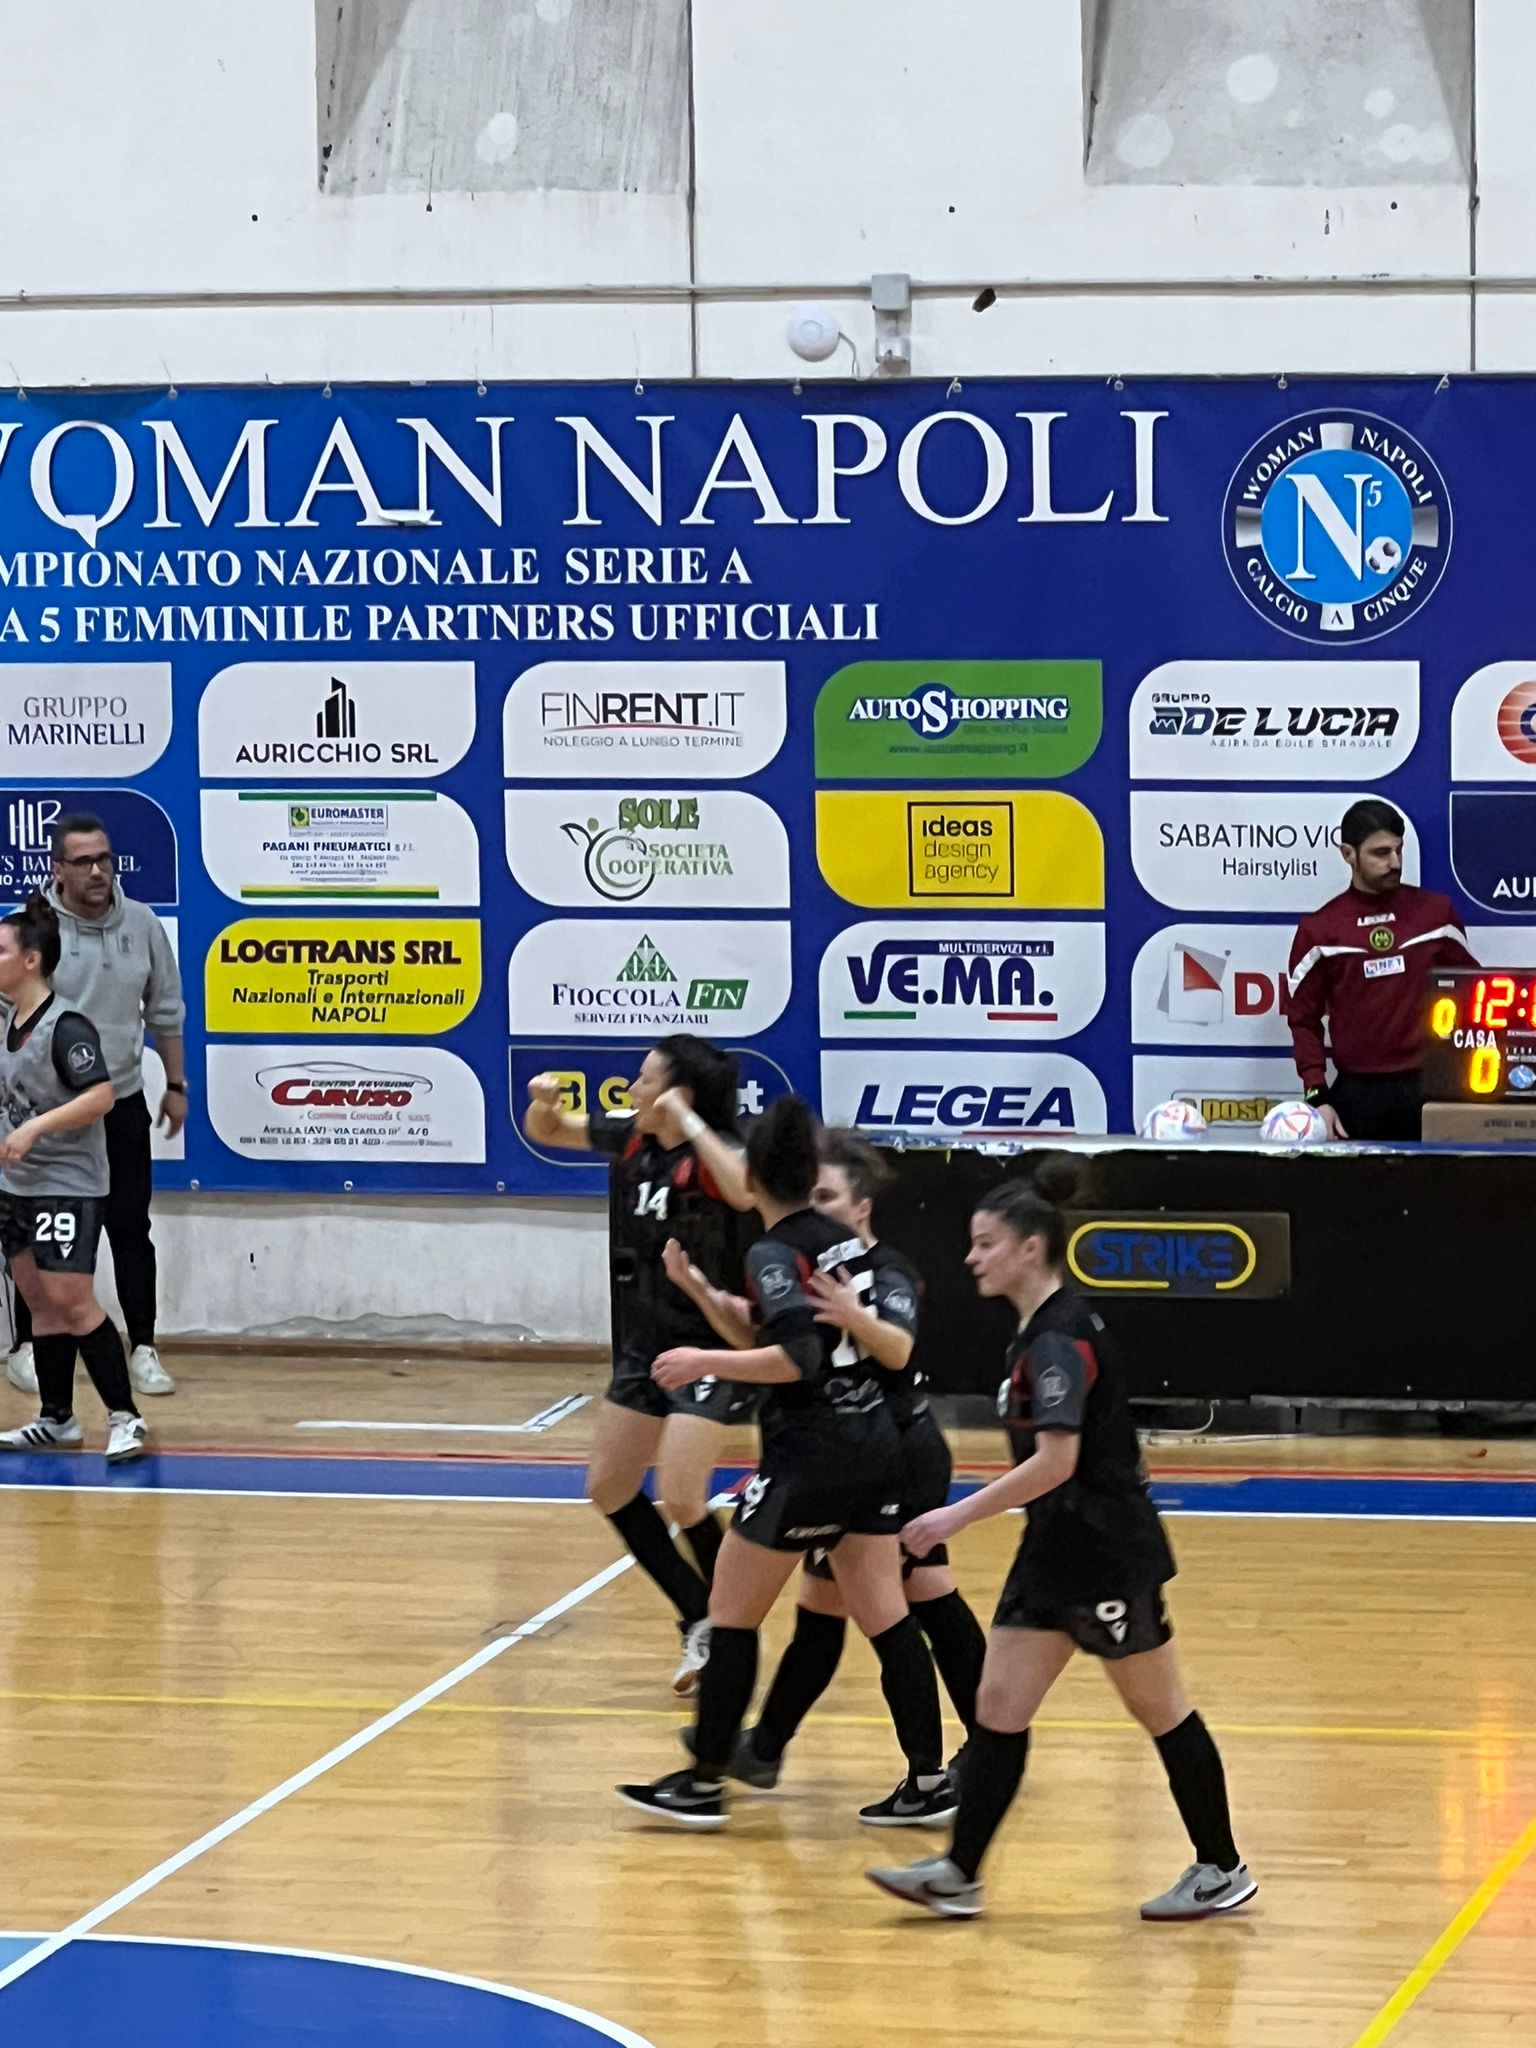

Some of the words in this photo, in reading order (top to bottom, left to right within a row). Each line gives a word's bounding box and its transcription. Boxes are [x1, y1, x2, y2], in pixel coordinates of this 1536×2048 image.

[0, 414, 514, 532] OMAN
[555, 410, 1169, 526] NAPOLI
[1243, 427, 1315, 501] WOMAN
[1360, 427, 1432, 503] NAPOLI
[1285, 473, 1373, 581] N
[1366, 480, 1383, 507] 5
[256, 548, 538, 585] NAZIONALE
[565, 547, 708, 585] SERIE
[721, 547, 752, 584] A
[1247, 558, 1309, 623] CALCIO
[1363, 557, 1428, 623] CINQUE
[0, 607, 29, 643] A
[39, 607, 61, 643] 5
[74, 605, 351, 643] FEMMINILE
[366, 604, 614, 642] PARTNERS
[630, 603, 880, 641] UFFICIALI
[23, 696, 128, 719] GRUPPO
[541, 691, 745, 726] FINRENT.IT
[1151, 693, 1211, 704] GRUPPO
[1181, 706, 1248, 736] DE
[1253, 706, 1400, 736] LUCIA
[8, 722, 146, 746] MARINELLI
[543, 735, 614, 748] NOLEGGIO
[619, 735, 629, 747] A
[684, 735, 744, 748] TERMINE
[235, 743, 381, 764] AURICCHIO
[390, 743, 438, 764] SRL
[311, 807, 384, 819] EUROMASTER
[618, 797, 700, 831] SOLE
[922, 815, 993, 837] ideas
[1159, 823, 1298, 849] SABATINO
[262, 842, 310, 851] PAGANI
[313, 842, 391, 851] PNEUMATICI
[923, 840, 992, 863] design
[924, 864, 999, 884] agency
[1222, 856, 1319, 880] Hairstylist
[1492, 876, 1536, 898] AU
[220, 939, 396, 964] LOGTRANS
[404, 940, 462, 965] SRL
[938, 942, 1023, 954] MULTISERVIZI
[307, 969, 389, 988] Trasporti
[847, 950, 1054, 1005] VE.MA.
[232, 987, 318, 1004] Nazionali
[323, 991, 334, 1004] e
[340, 986, 465, 1006] Internazionali
[551, 982, 681, 1007] FIOCCOLA
[691, 982, 743, 1007] FIN
[311, 1007, 387, 1023] NAPOLI
[574, 1013, 627, 1025] SERVIZI
[630, 1013, 709, 1025] FINANZIARI
[1432, 997, 1457, 1038] 0
[1453, 1029, 1497, 1048] CASA
[1469, 1048, 1501, 1094] 0
[271, 1079, 413, 1107] CARUSO
[854, 1084, 1076, 1128] LEGEA
[633, 1181, 671, 1221] 14
[35, 1212, 76, 1241] 29
[1091, 1231, 1233, 1278] STRIKE
